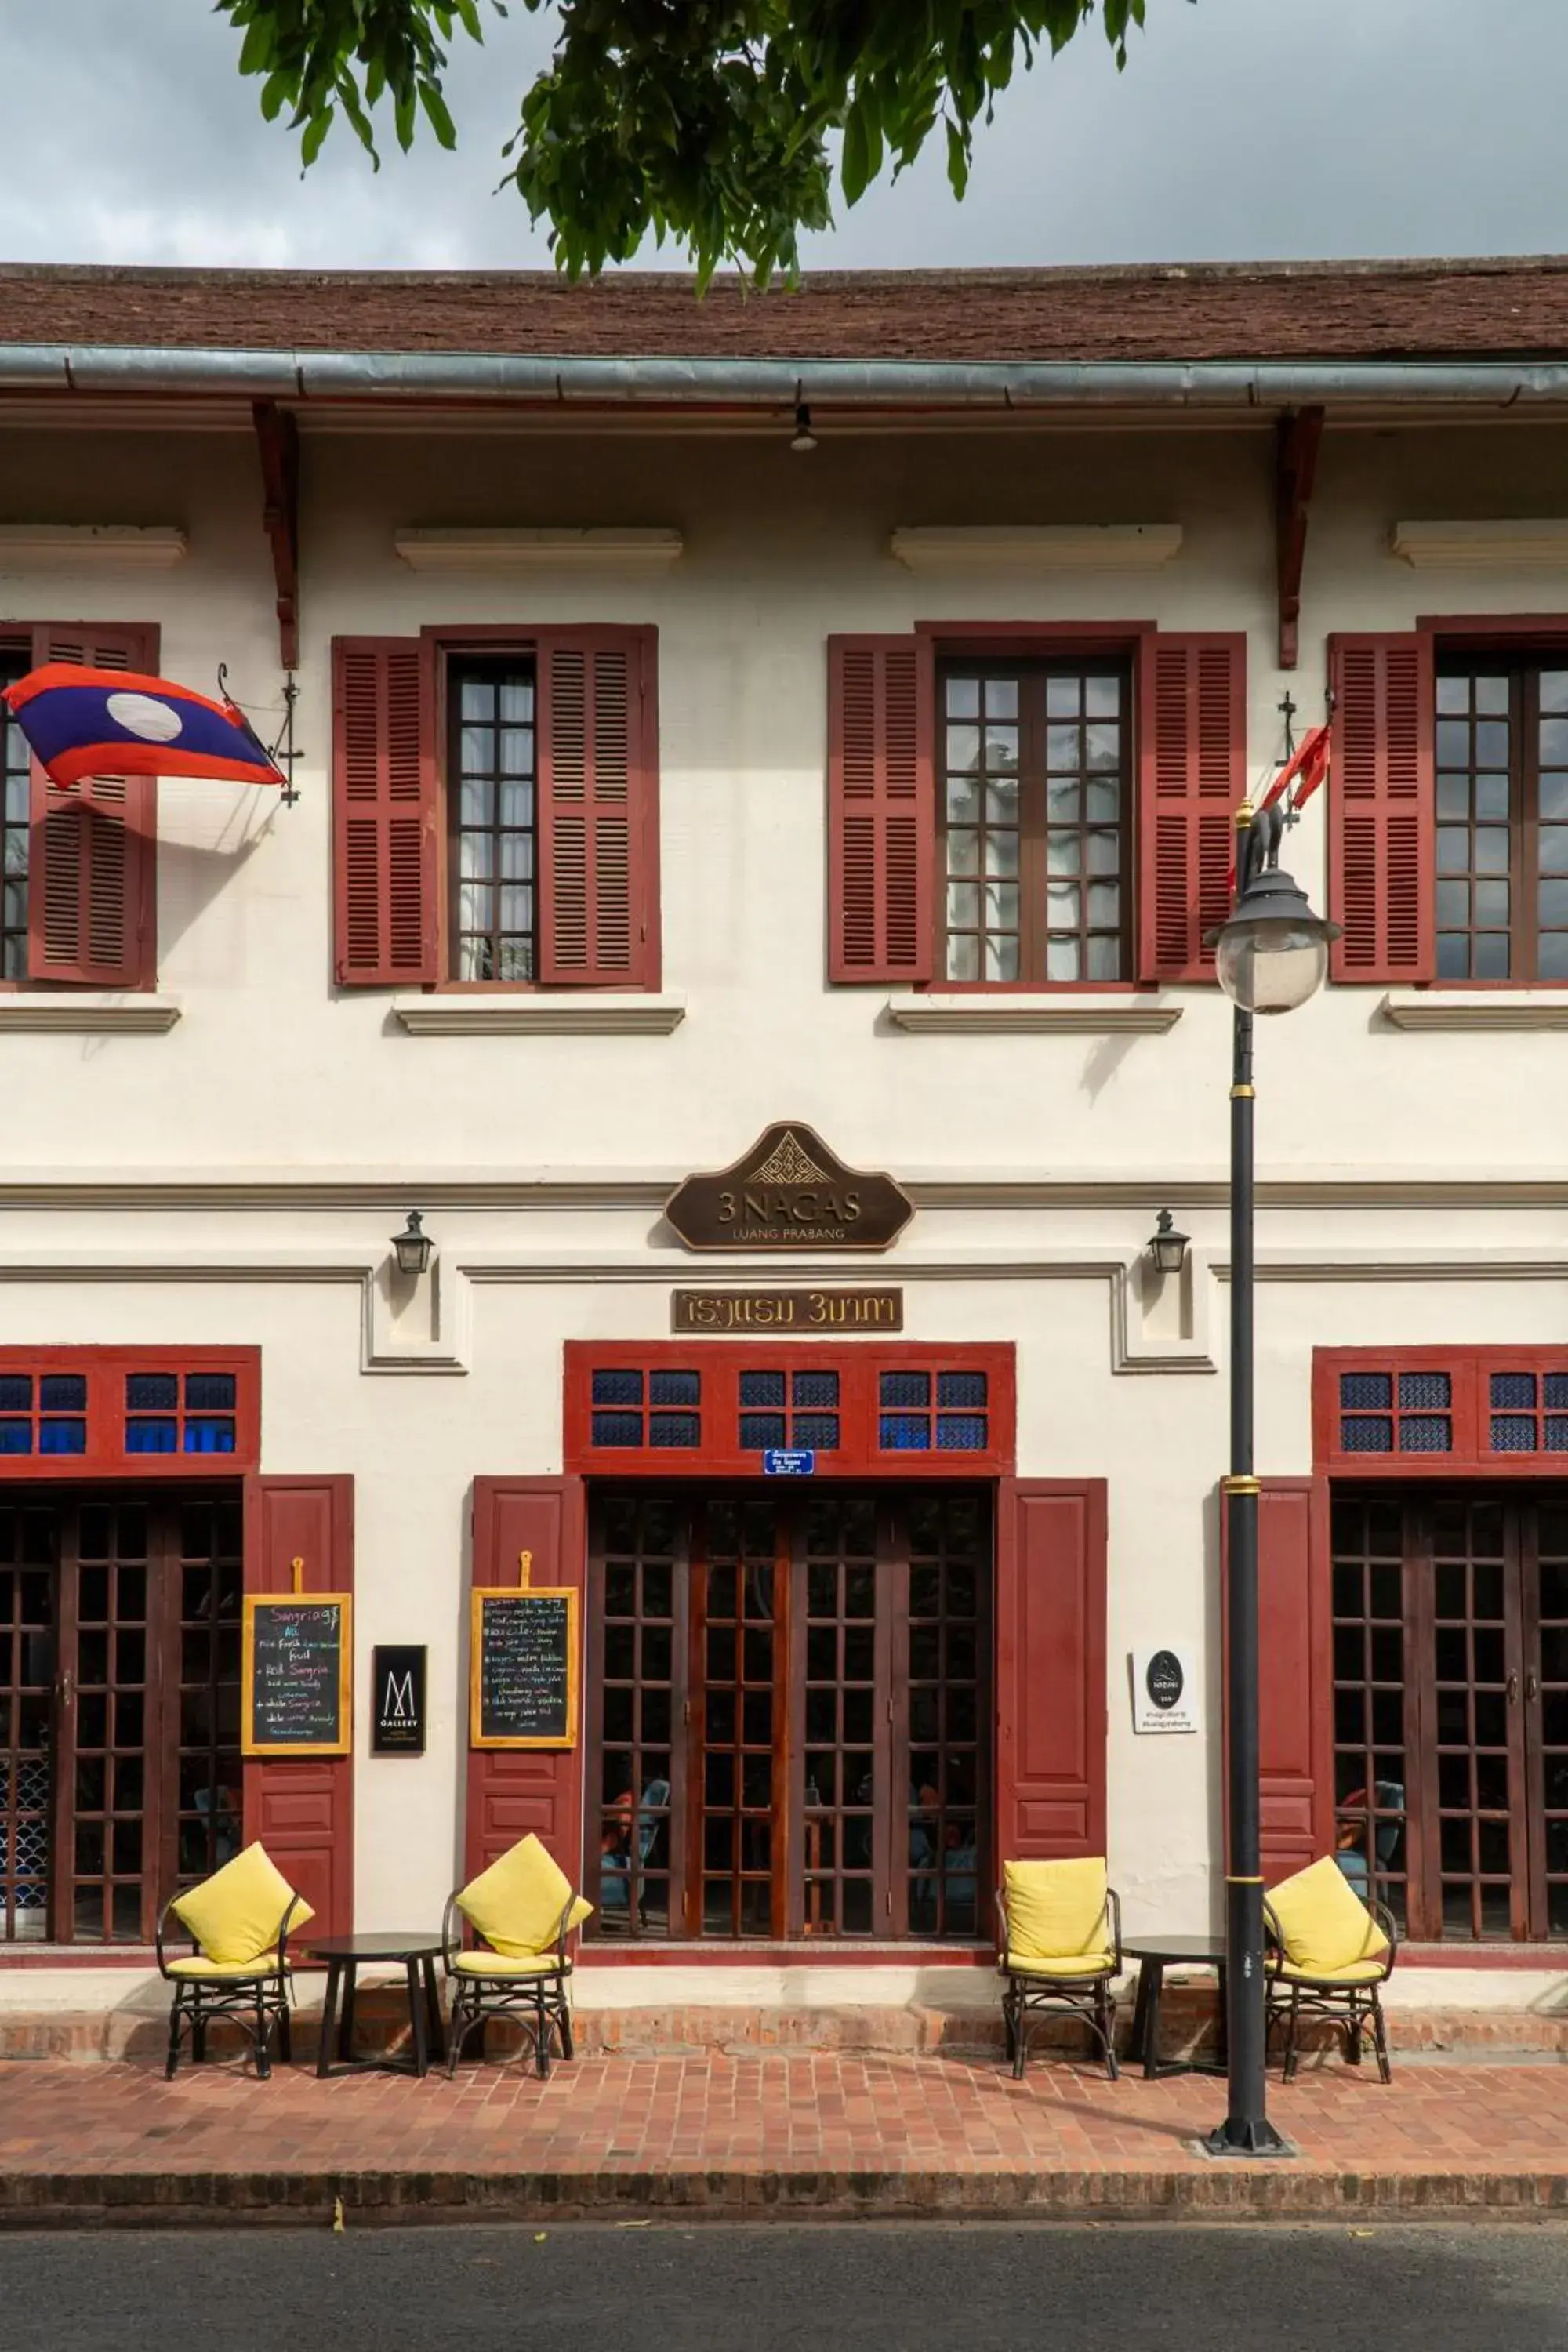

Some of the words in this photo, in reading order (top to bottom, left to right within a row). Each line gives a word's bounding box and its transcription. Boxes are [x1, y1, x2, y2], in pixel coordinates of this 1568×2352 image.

[718, 1192, 736, 1223] 3
[743, 1192, 862, 1224] NAGAS
[732, 1229, 779, 1240] LUANG
[783, 1229, 845, 1240] PRABANG
[270, 1606, 321, 1627] Sangria
